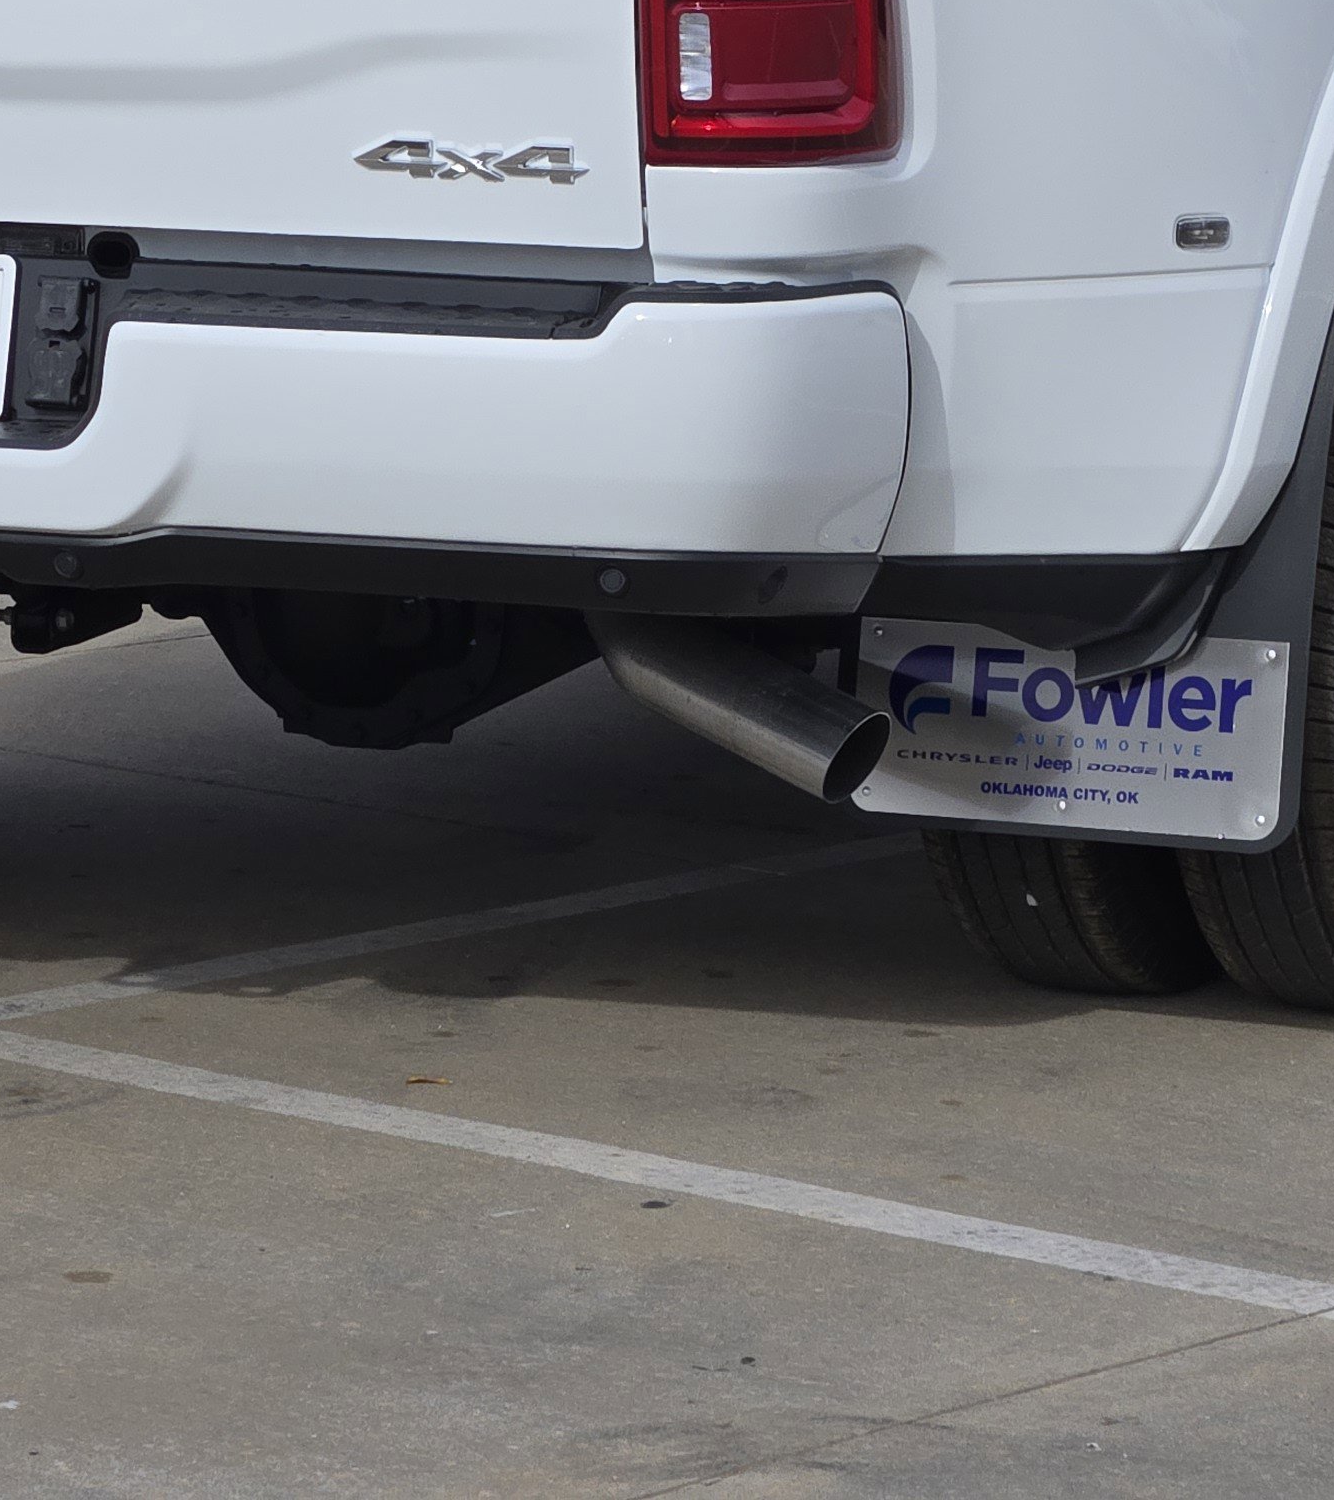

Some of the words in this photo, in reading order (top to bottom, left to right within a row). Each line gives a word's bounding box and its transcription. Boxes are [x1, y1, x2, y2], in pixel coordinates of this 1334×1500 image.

[970, 645, 1253, 734] Fowler
[1013, 732, 1204, 758] AUTOMOTIVE
[896, 748, 1019, 767] CHRYSLER
[1033, 754, 1073, 774] Jeep
[1086, 763, 1159, 776] DODGE
[1173, 767, 1234, 783] RAM
[980, 780, 1069, 800] OKLAHOMA
[1072, 785, 1112, 806] CITY,
[1116, 788, 1139, 804] OK
